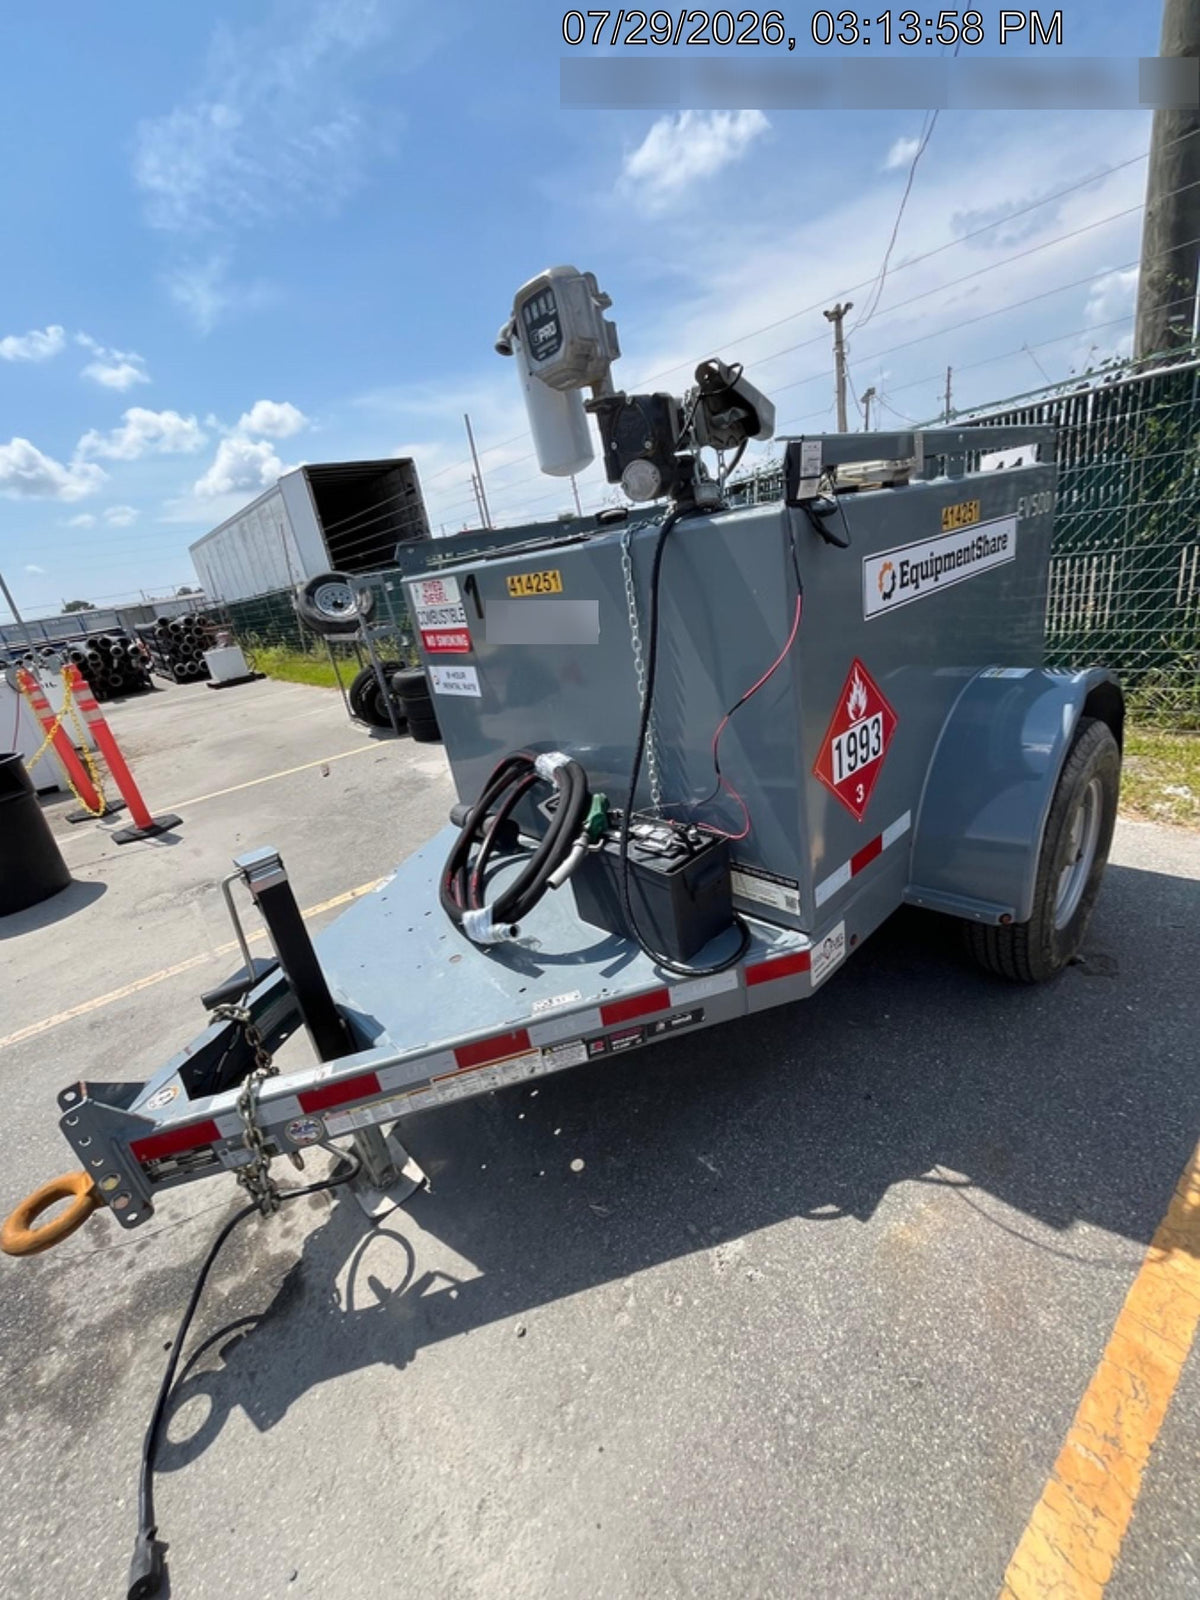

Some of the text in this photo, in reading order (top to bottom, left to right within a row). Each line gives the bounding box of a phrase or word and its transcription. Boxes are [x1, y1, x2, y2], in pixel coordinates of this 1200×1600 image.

[943, 502, 978, 527] 414251
[900, 533, 1008, 589] EquipmentShare
[509, 571, 560, 595] 414251
[463, 573, 484, 619] 1
[417, 607, 467, 625] COMBUSTIBLE
[425, 634, 468, 648] NO SMOKING
[834, 717, 882, 779] 1993
[856, 784, 865, 803] 3
